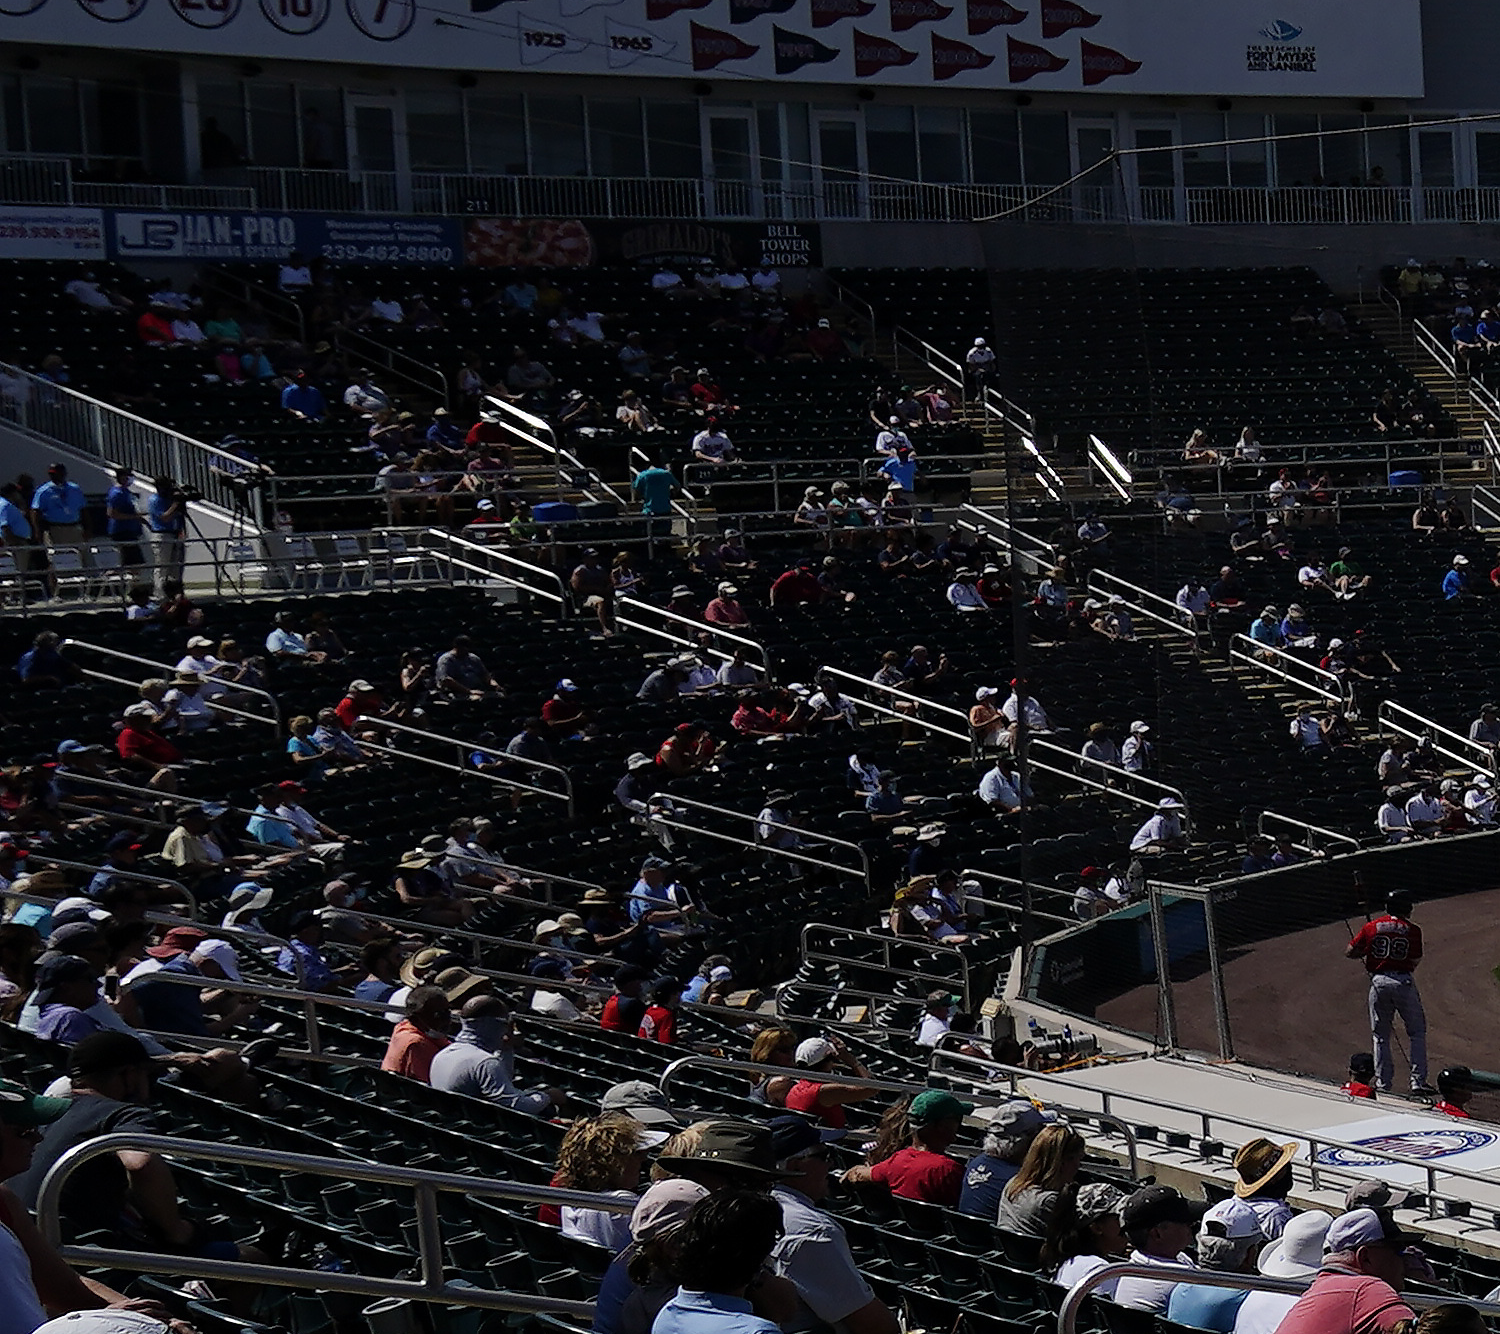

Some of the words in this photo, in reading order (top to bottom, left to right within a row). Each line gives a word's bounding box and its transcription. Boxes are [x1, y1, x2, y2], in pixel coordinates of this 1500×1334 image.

[524, 31, 567, 48] 1925
[610, 35, 654, 53] 1965
[1247, 51, 1273, 62] FORT
[1277, 51, 1316, 63] MYERS
[466, 200, 489, 212] 211
[183, 214, 296, 245] JAN-PRO
[768, 224, 802, 238] BELL
[760, 239, 811, 251] TOWER
[763, 253, 809, 265] SHOPS
